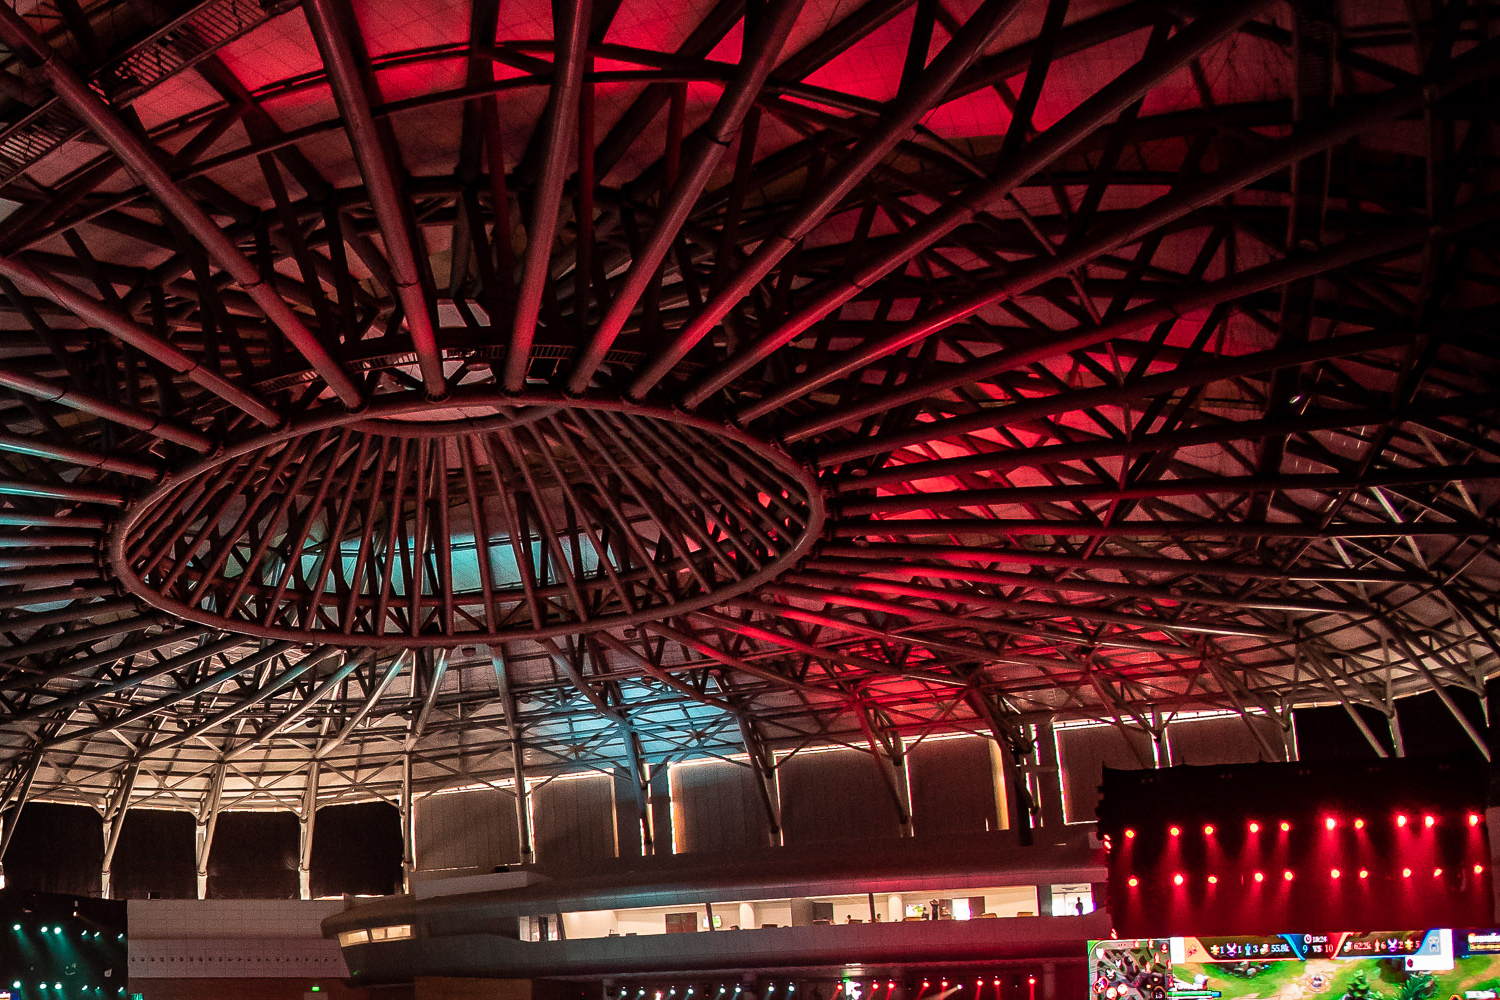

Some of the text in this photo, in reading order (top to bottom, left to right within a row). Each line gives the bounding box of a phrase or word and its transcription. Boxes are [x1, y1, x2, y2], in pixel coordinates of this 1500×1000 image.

[1415, 940, 1421, 948] 5
[1252, 945, 1258, 953] 3
[1303, 944, 1308, 954] 9
[1325, 944, 1334, 953] 10
